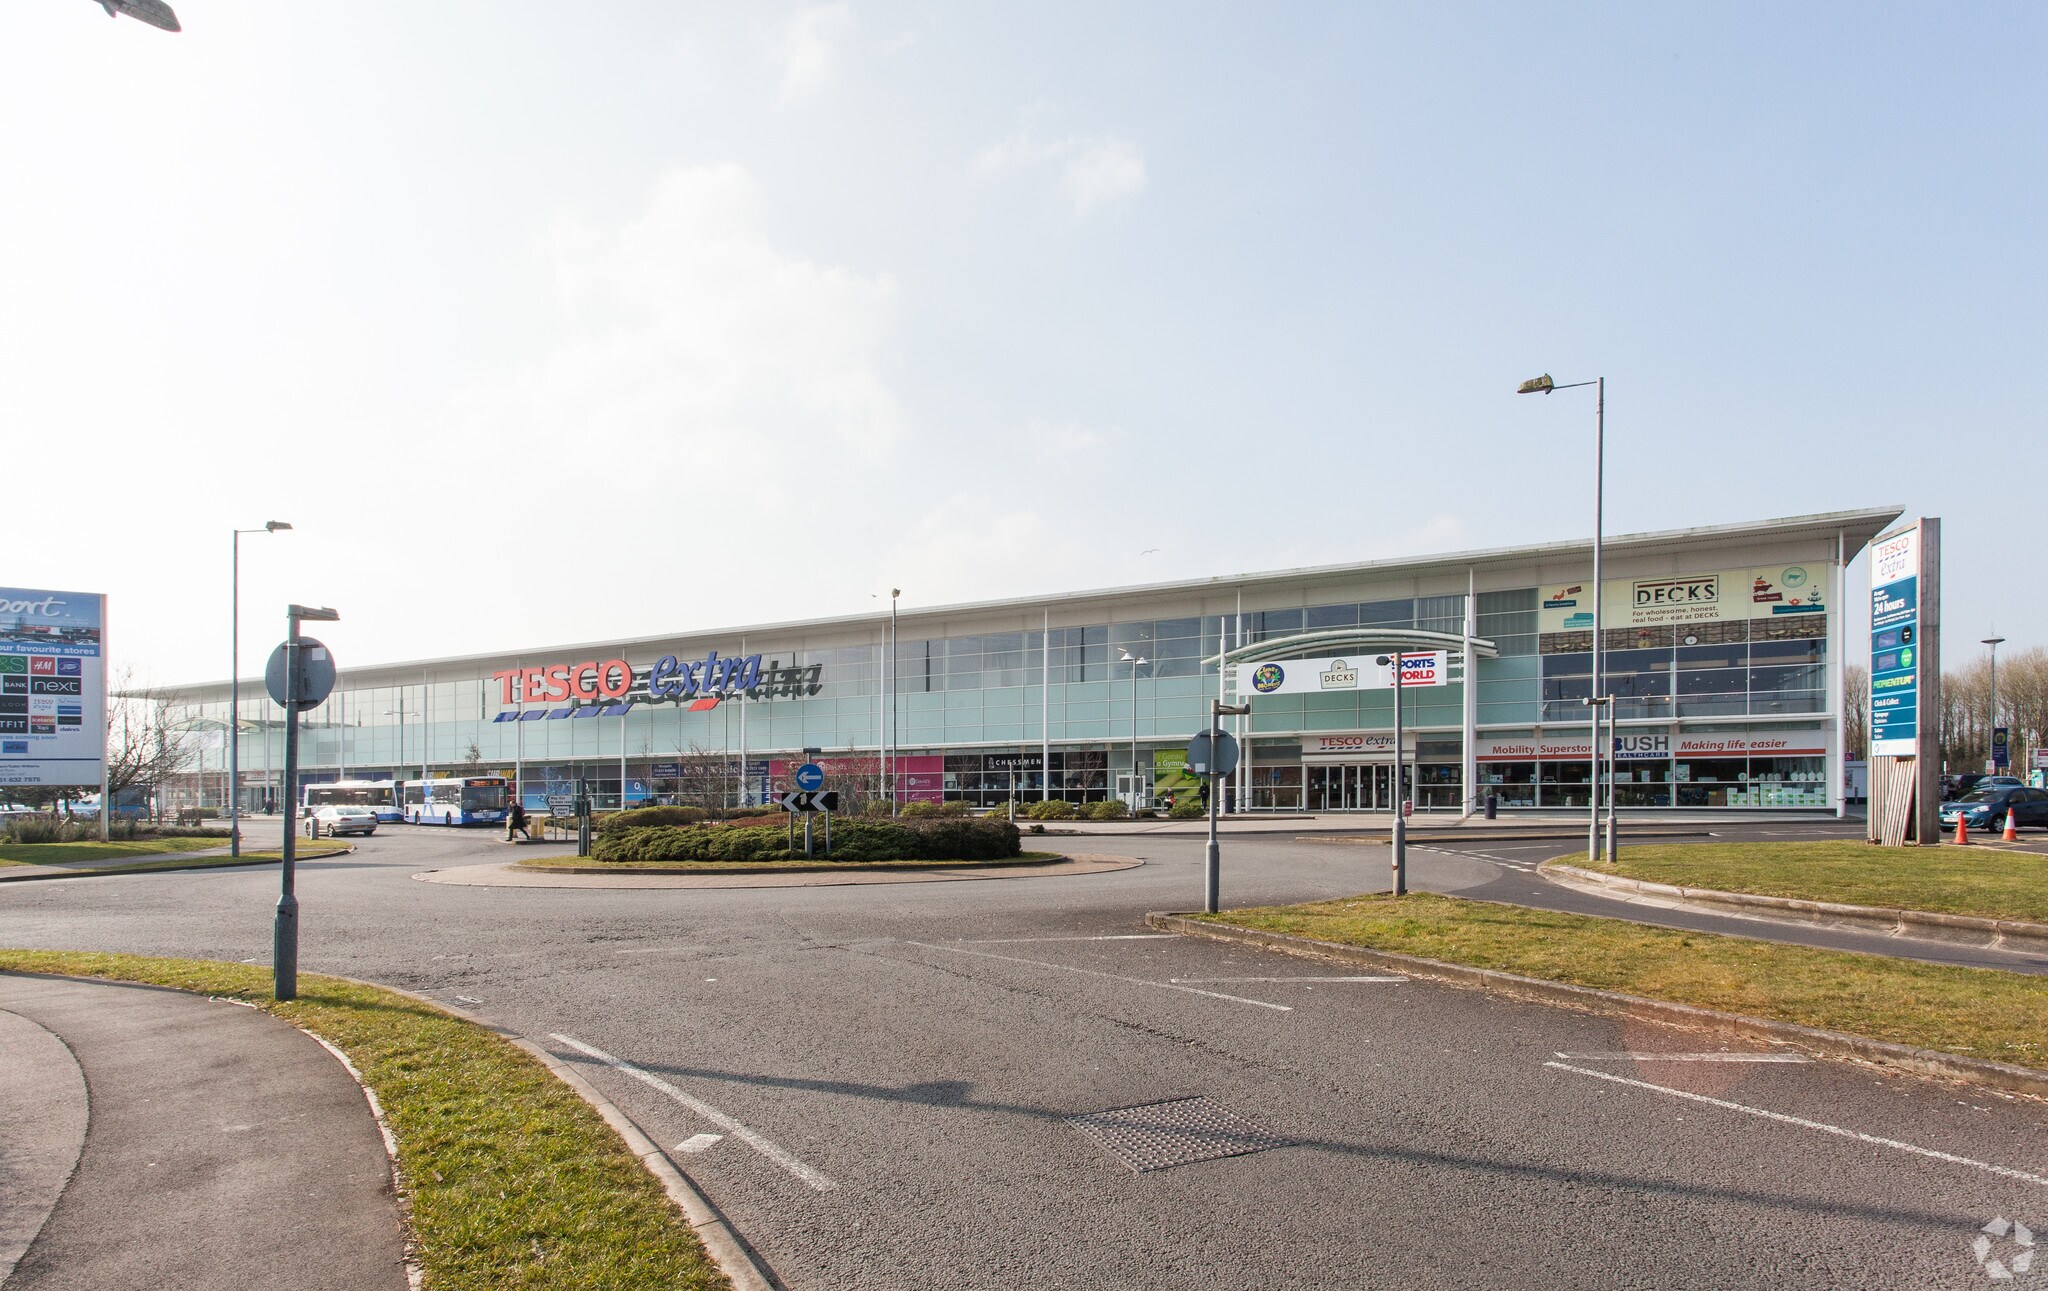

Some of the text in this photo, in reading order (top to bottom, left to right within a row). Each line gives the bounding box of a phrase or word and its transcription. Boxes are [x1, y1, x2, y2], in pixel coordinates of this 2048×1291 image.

[1879, 538, 1909, 557] TESCO
[1881, 559, 1906, 576] extra
[1637, 584, 1715, 604] DECKS
[16, 644, 62, 654] favourite
[63, 647, 96, 656] stores
[650, 651, 762, 697] extra
[1324, 673, 1354, 682] DECKS
[34, 681, 79, 692] next
[493, 659, 633, 705] TESCO
[1319, 736, 1364, 747] TESCO
[1680, 739, 1788, 752] Making life easier
[1492, 743, 1595, 756] Mobility Superstor
[995, 758, 1042, 767] CHESSMEN
[421, 770, 451, 780] UBWAY
[486, 768, 518, 780] SUBWAY
